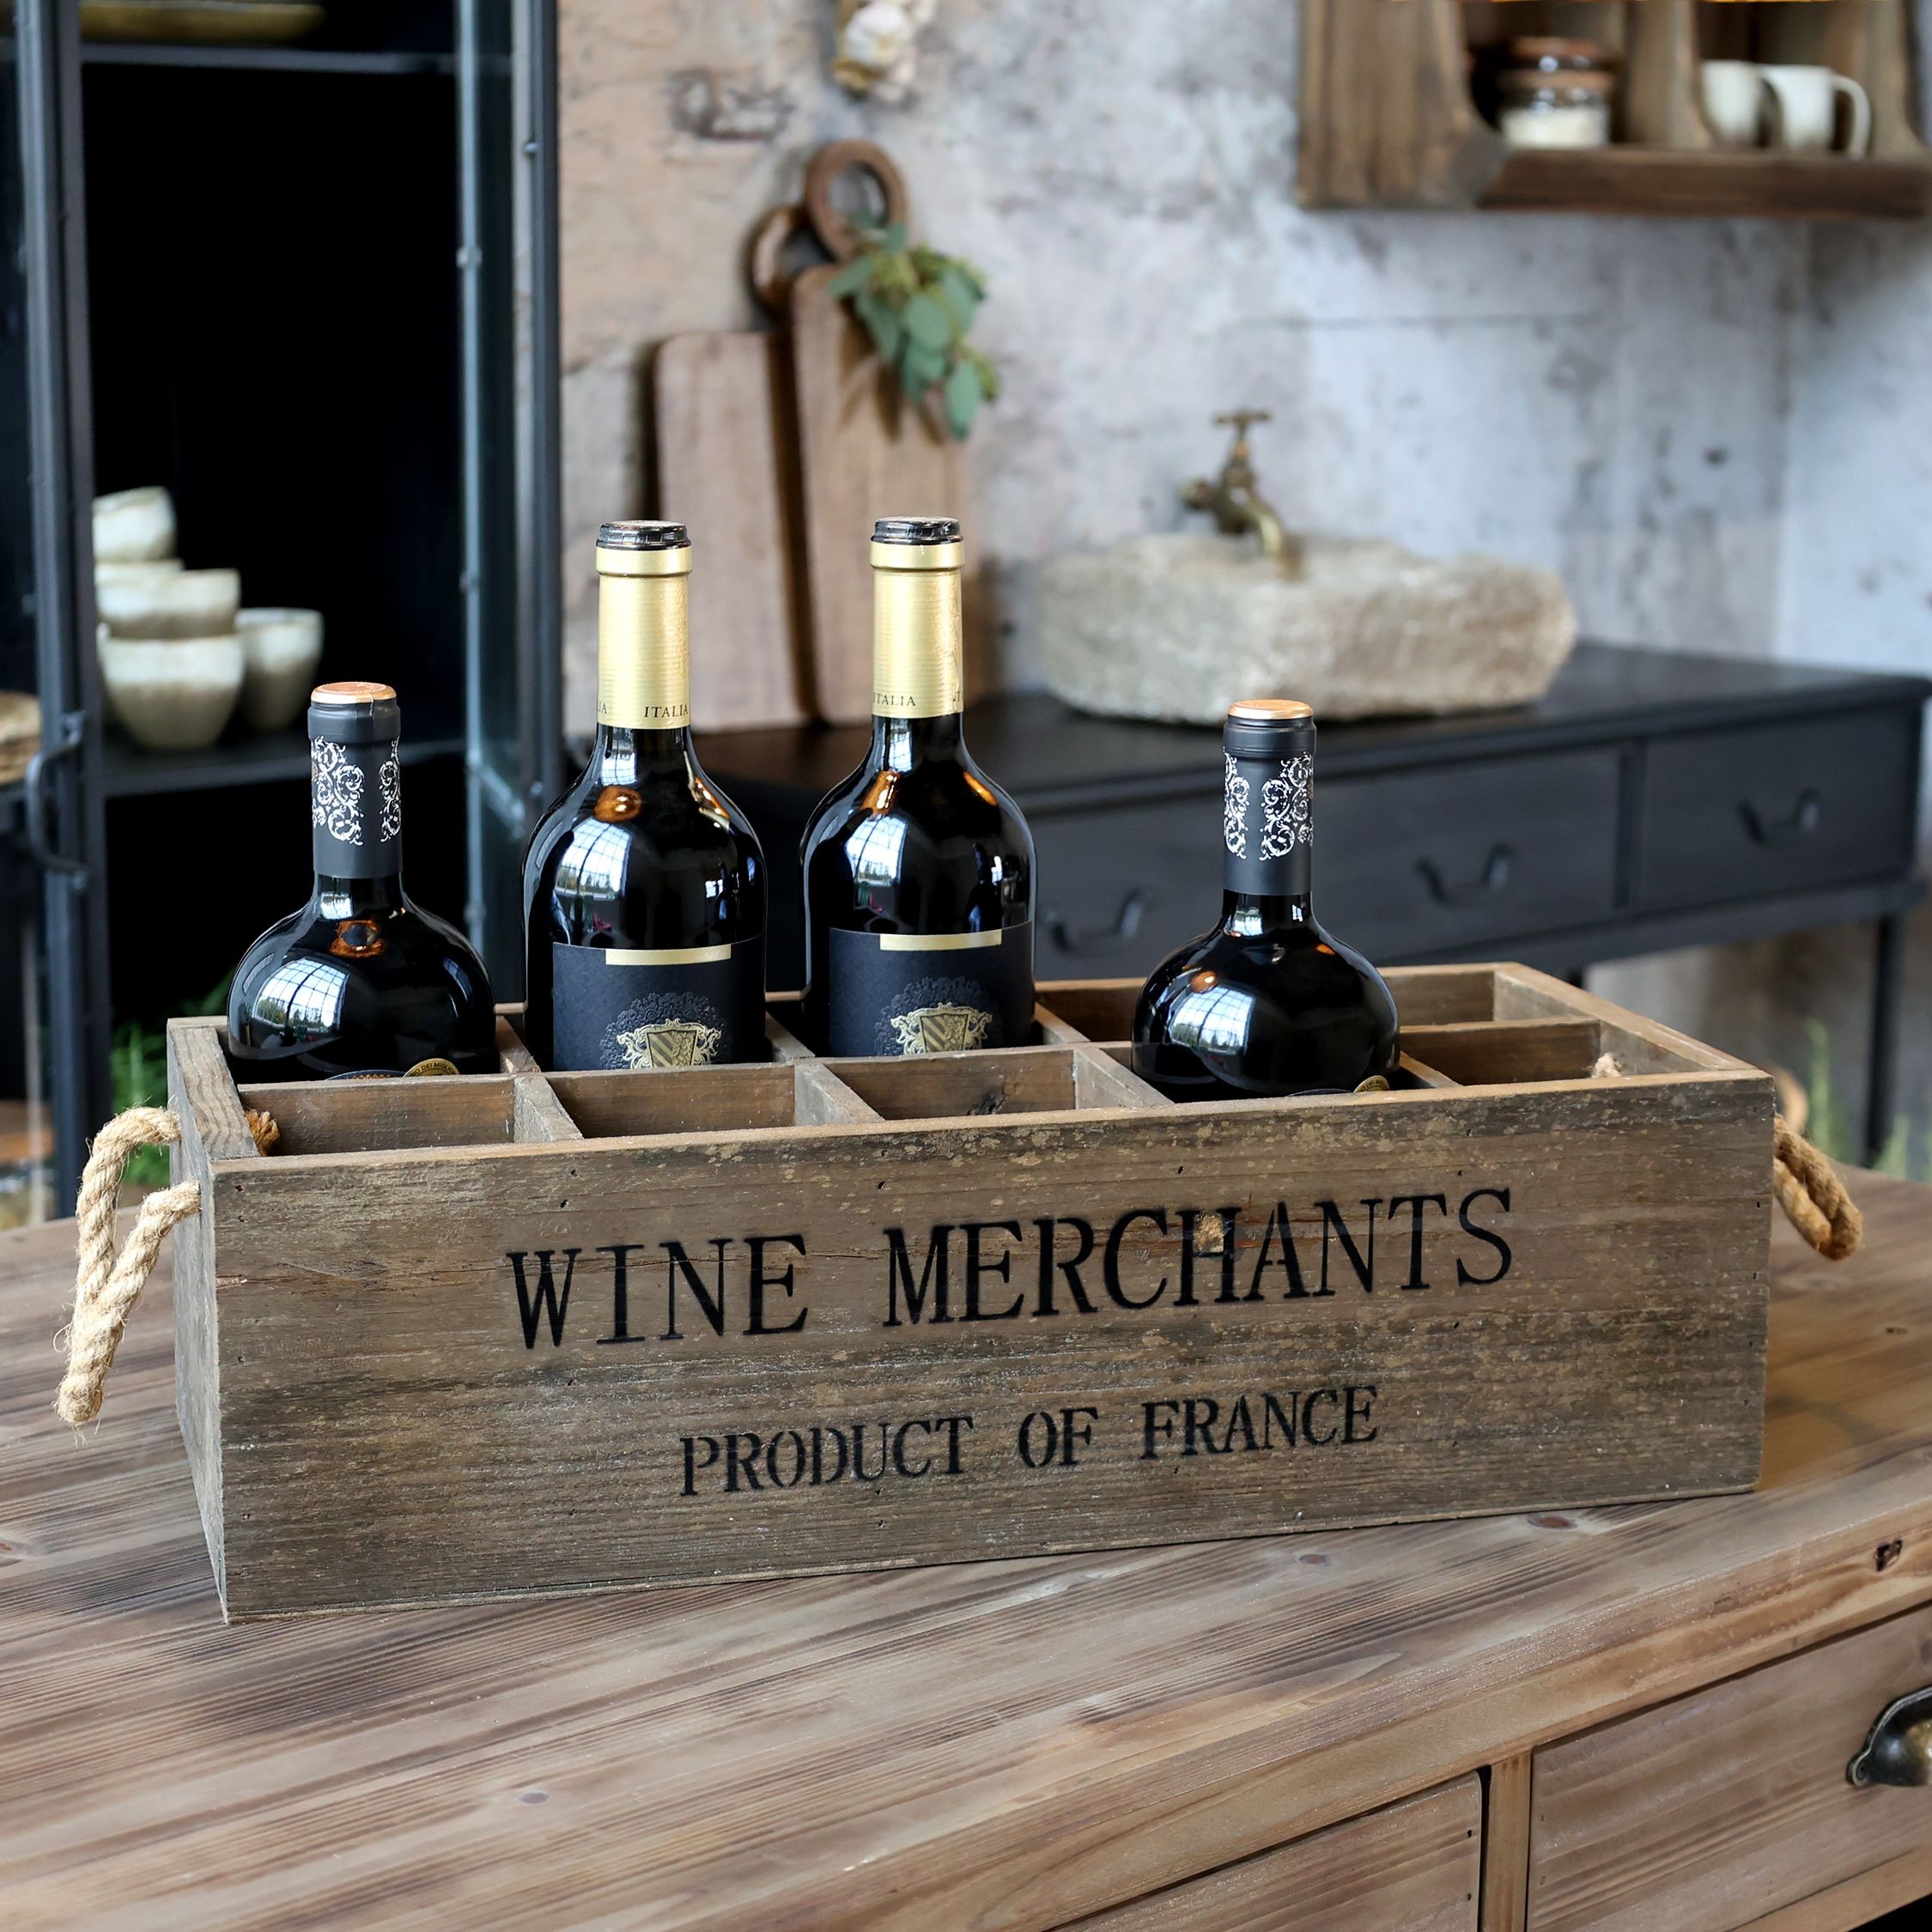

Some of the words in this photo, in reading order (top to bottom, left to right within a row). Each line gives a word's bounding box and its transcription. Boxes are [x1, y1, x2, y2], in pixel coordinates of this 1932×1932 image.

[644, 704, 689, 718] ITALIA
[872, 692, 916, 706] ITALIA
[505, 1233, 809, 1351] WINE
[882, 1187, 1512, 1327] MERCHANTS
[679, 1415, 974, 1497] PRODUCT
[1018, 1406, 1099, 1468] OF
[1139, 1384, 1378, 1460] FRANCE
